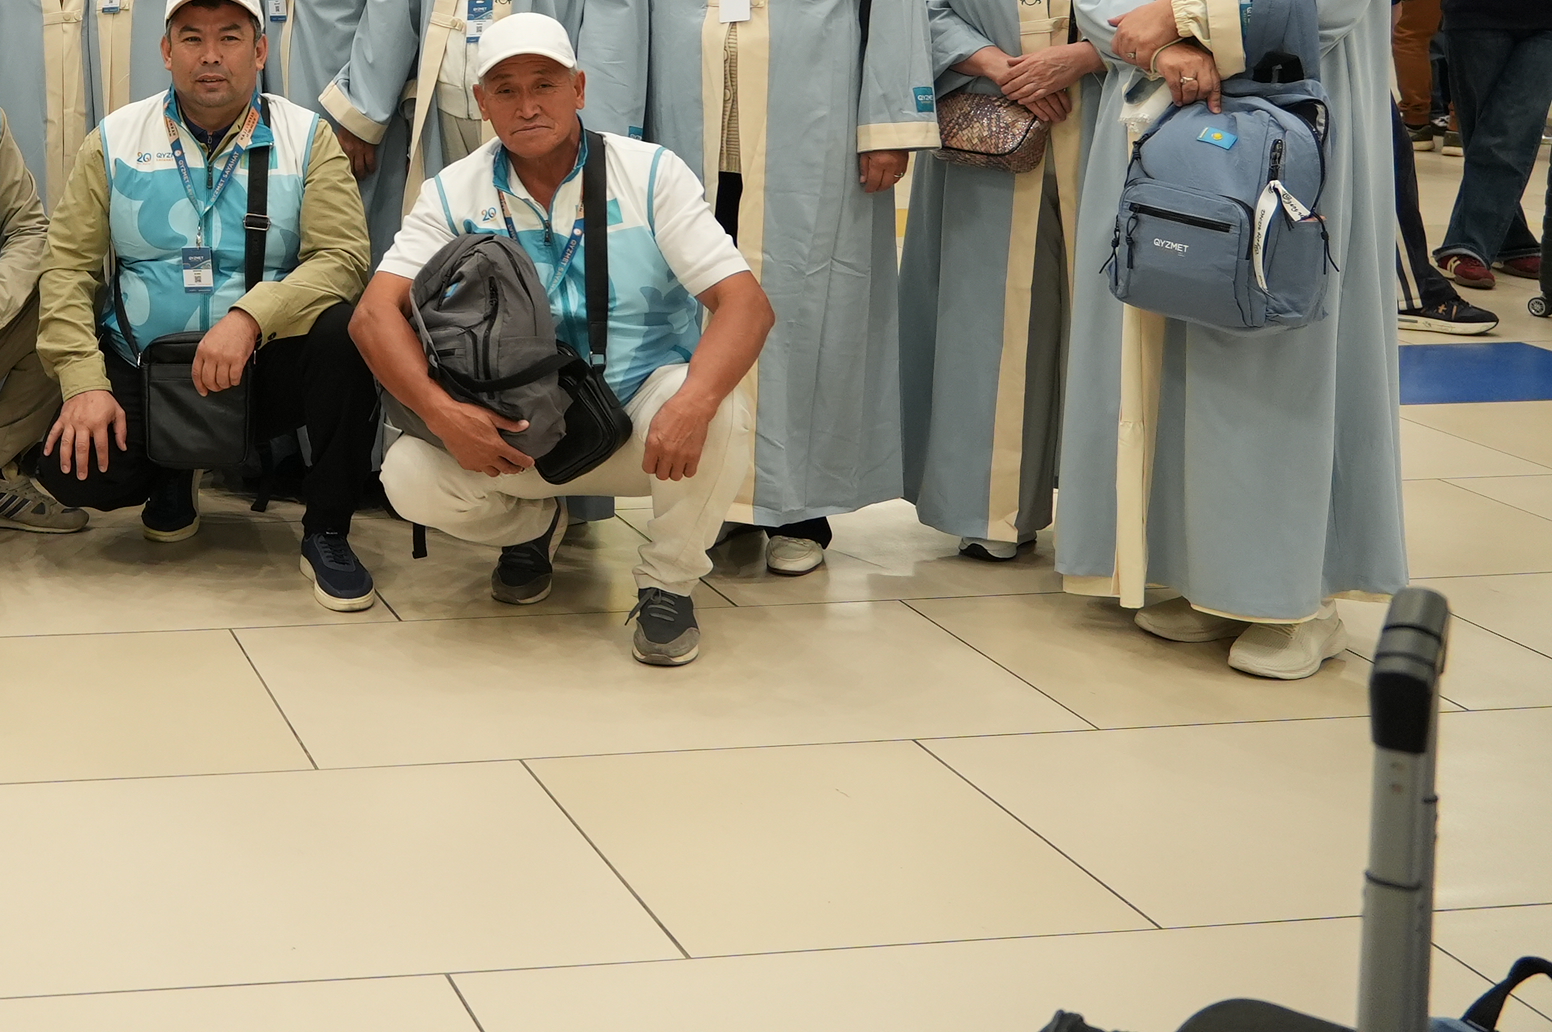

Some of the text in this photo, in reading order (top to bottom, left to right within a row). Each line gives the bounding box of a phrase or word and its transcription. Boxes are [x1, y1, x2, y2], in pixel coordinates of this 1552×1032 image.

[179, 160, 189, 184] QYZMET
[223, 151, 240, 178] SAYAHAT
[561, 239, 577, 266] QYZMET
[1153, 238, 1189, 253] QYZMET
